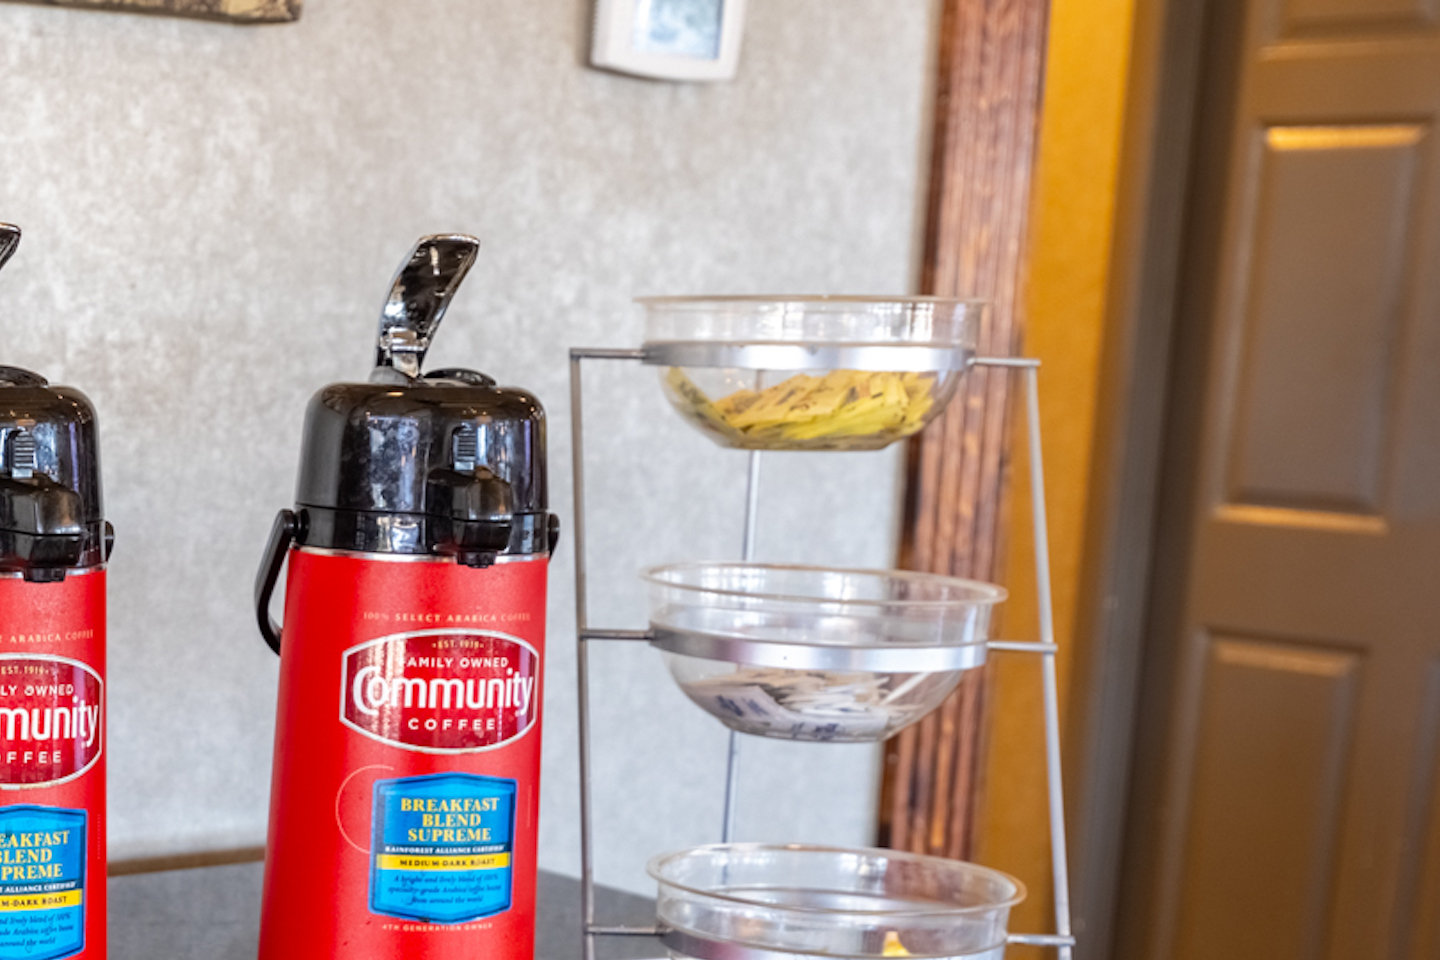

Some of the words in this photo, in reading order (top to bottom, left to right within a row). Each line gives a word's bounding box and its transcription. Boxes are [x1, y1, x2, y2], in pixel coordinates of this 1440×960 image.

[395, 612, 440, 622] SELECT
[447, 613, 497, 623] ARABICA
[10, 632, 61, 644] ARABICA
[403, 656, 454, 668] AMILY
[459, 656, 510, 668] OWNED
[24, 683, 74, 697] OWNED
[353, 665, 534, 716] Community
[408, 718, 496, 731] COFFEE
[400, 797, 500, 812] BREAKFAST
[422, 813, 482, 827] BLEND
[408, 827, 492, 842] SUPREME
[385, 845, 434, 854] RAINFOREST
[434, 846, 472, 854] ALLIANCE
[4, 884, 43, 894] ALLIANCE
[42, 896, 67, 905] ROAST
